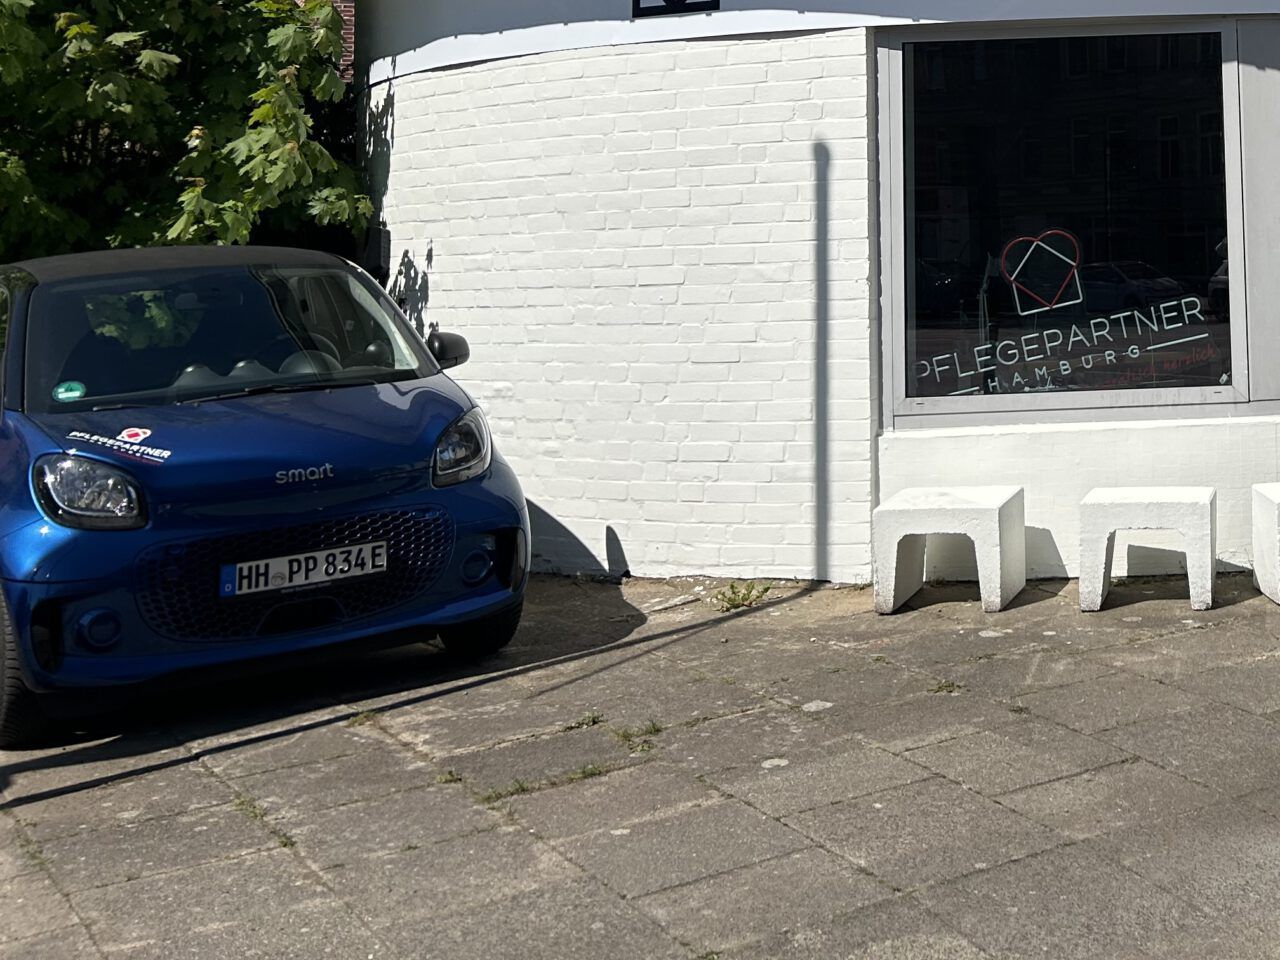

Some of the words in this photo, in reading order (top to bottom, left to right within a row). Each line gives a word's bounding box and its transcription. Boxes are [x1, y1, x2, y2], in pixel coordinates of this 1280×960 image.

[912, 297, 1205, 386] PFLEGEPARTNER
[987, 345, 1140, 392] HAMBURG
[275, 462, 334, 484] smart
[237, 562, 270, 592] HH
[288, 555, 318, 583] PP
